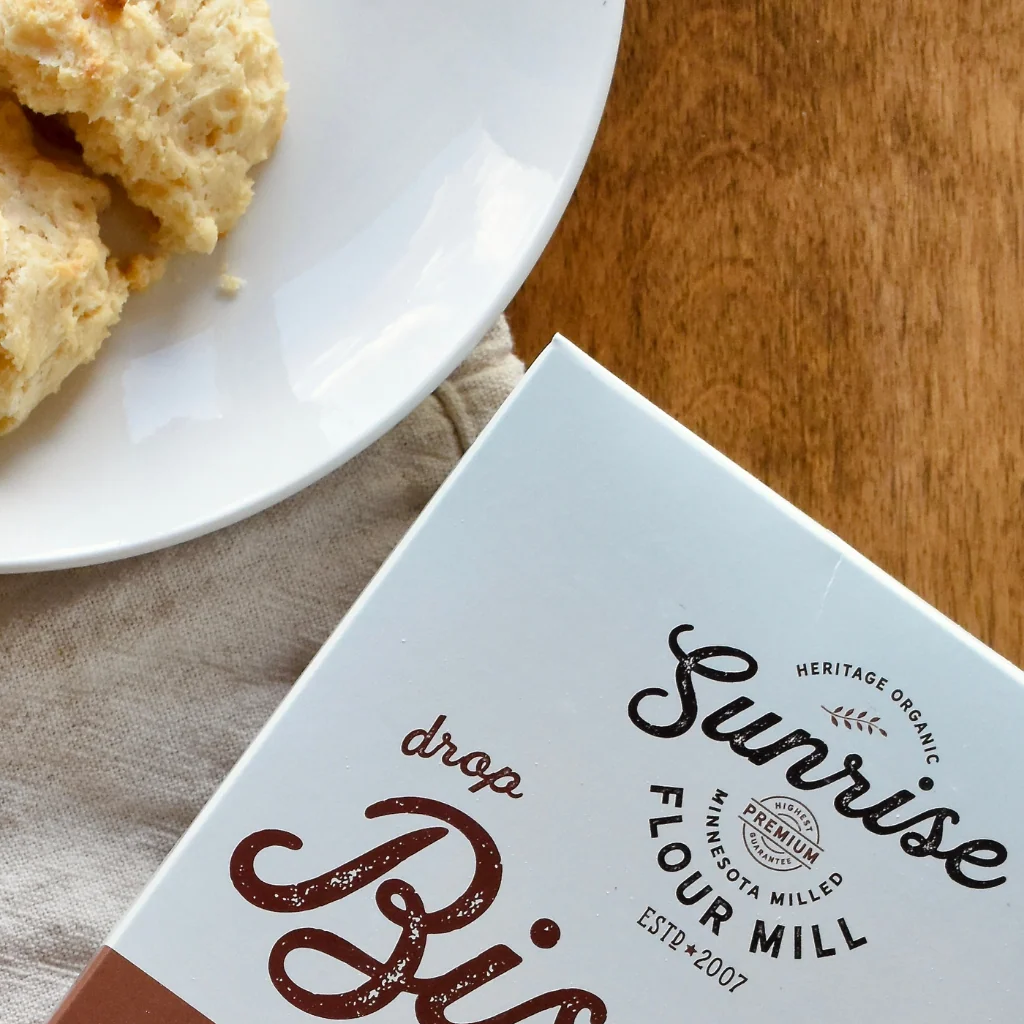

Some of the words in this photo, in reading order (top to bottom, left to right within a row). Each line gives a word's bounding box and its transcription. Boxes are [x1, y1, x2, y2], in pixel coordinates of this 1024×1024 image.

[400, 716, 523, 801] drop
[628, 624, 1007, 889] Sunrise
[796, 662, 888, 692] HERITAGE
[890, 688, 939, 765] ORGANIC
[706, 789, 761, 899] MINNESOTA
[770, 871, 843, 907] MILLED
[743, 803, 820, 865] PREMIUM
[749, 832, 792, 866] GUARANTEE
[775, 801, 813, 833] HIGHEST
[649, 784, 734, 936] FLOUR
[749, 917, 867, 959] MILL
